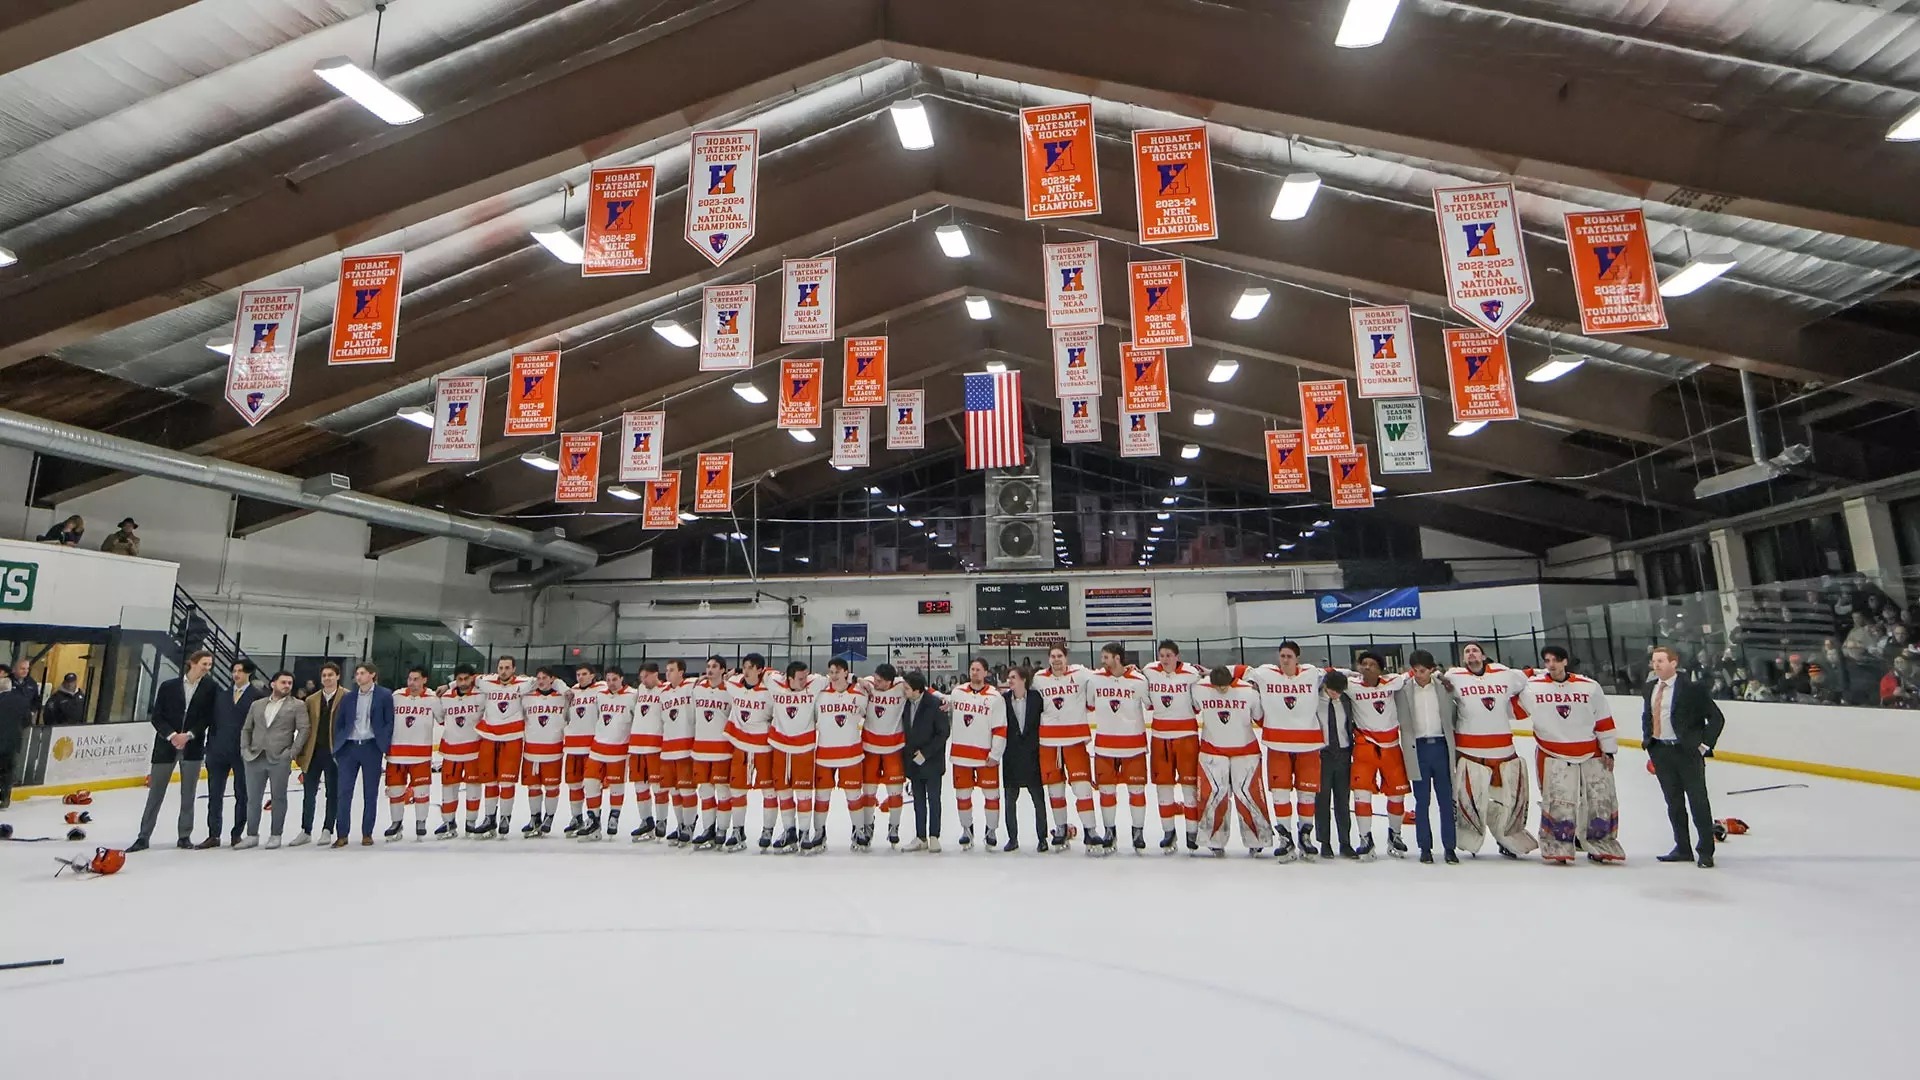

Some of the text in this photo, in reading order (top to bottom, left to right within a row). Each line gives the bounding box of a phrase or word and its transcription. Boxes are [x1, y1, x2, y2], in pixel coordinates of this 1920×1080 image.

[1038, 112, 1077, 122] HOBART
[1029, 119, 1086, 131] STATESMEN
[1039, 129, 1078, 139] HOCKEY
[706, 137, 743, 145] HOBART
[1151, 135, 1191, 144] HOBART
[697, 145, 750, 154] STATESMEN
[1141, 142, 1201, 154] STATESMEN
[1152, 152, 1193, 161] HOCKEY
[605, 173, 640, 182] HOBART
[1041, 175, 1081, 186] 2023-24
[595, 181, 648, 190] STATESMEN
[1048, 184, 1075, 192] NEHC
[603, 189, 639, 198] HOCKEY
[1040, 192, 1084, 202] PLAYOFF
[1453, 192, 1496, 202] HOBART
[698, 198, 744, 206] 2023-2024
[1033, 200, 1093, 212] CHAMPIONS
[1155, 198, 1196, 208] 2023-24
[1444, 200, 1508, 212] STATESMEN
[709, 206, 732, 214] NCAA
[1163, 208, 1190, 216] NEHC
[698, 214, 743, 223] NATIONAL
[1157, 216, 1197, 225] LEAGUE
[1456, 211, 1499, 221] HOCKEY
[1584, 214, 1625, 224] HOBART
[693, 222, 747, 231] CHAMPIONS
[1147, 224, 1209, 235] CHAMPIONS
[1575, 223, 1637, 235] STATESMEN
[1588, 234, 1629, 243] HOCKEY
[354, 261, 389, 270] HOBART
[588, 258, 643, 267] CHAMPIONS
[1457, 259, 1514, 270] 2022-2023
[345, 269, 395, 279] STATESMEN
[1136, 271, 1178, 279] STATESMEN
[1473, 269, 1502, 278] NCAA
[352, 278, 387, 286] HOCKEY
[1461, 278, 1517, 288] NATIONAL
[1457, 286, 1524, 299] CHAMPIONS
[1595, 284, 1643, 294] 2022-23
[253, 296, 287, 304] HOBART
[1604, 295, 1635, 304] NEHC
[244, 304, 293, 312] STATESMEN
[1052, 307, 1097, 315] TOURNAMENT
[1586, 304, 1656, 316] TOURNAMENT
[347, 323, 382, 331] 2024-25
[352, 331, 375, 339] NEHC
[344, 339, 382, 347] PLAYOFF
[336, 347, 388, 356] CHAMPIONS
[1364, 376, 1412, 384] TOURNAMENT
[1469, 400, 1500, 408] LEAGUE
[1461, 408, 1509, 416] CHAMPIONS
[1369, 607, 1417, 618] ICE HOCKEY
[1149, 684, 1187, 692] HOBART
[1267, 684, 1312, 693] HOBART
[1461, 685, 1508, 696] HOBART
[773, 695, 814, 703] HOBART
[1536, 693, 1589, 703] HOBART
[820, 704, 859, 713] HOBART
[953, 701, 990, 715] HOBART
[1202, 700, 1246, 709] HOBART
[77, 735, 106, 746] BANK
[75, 744, 148, 758] FINGER LAKES
